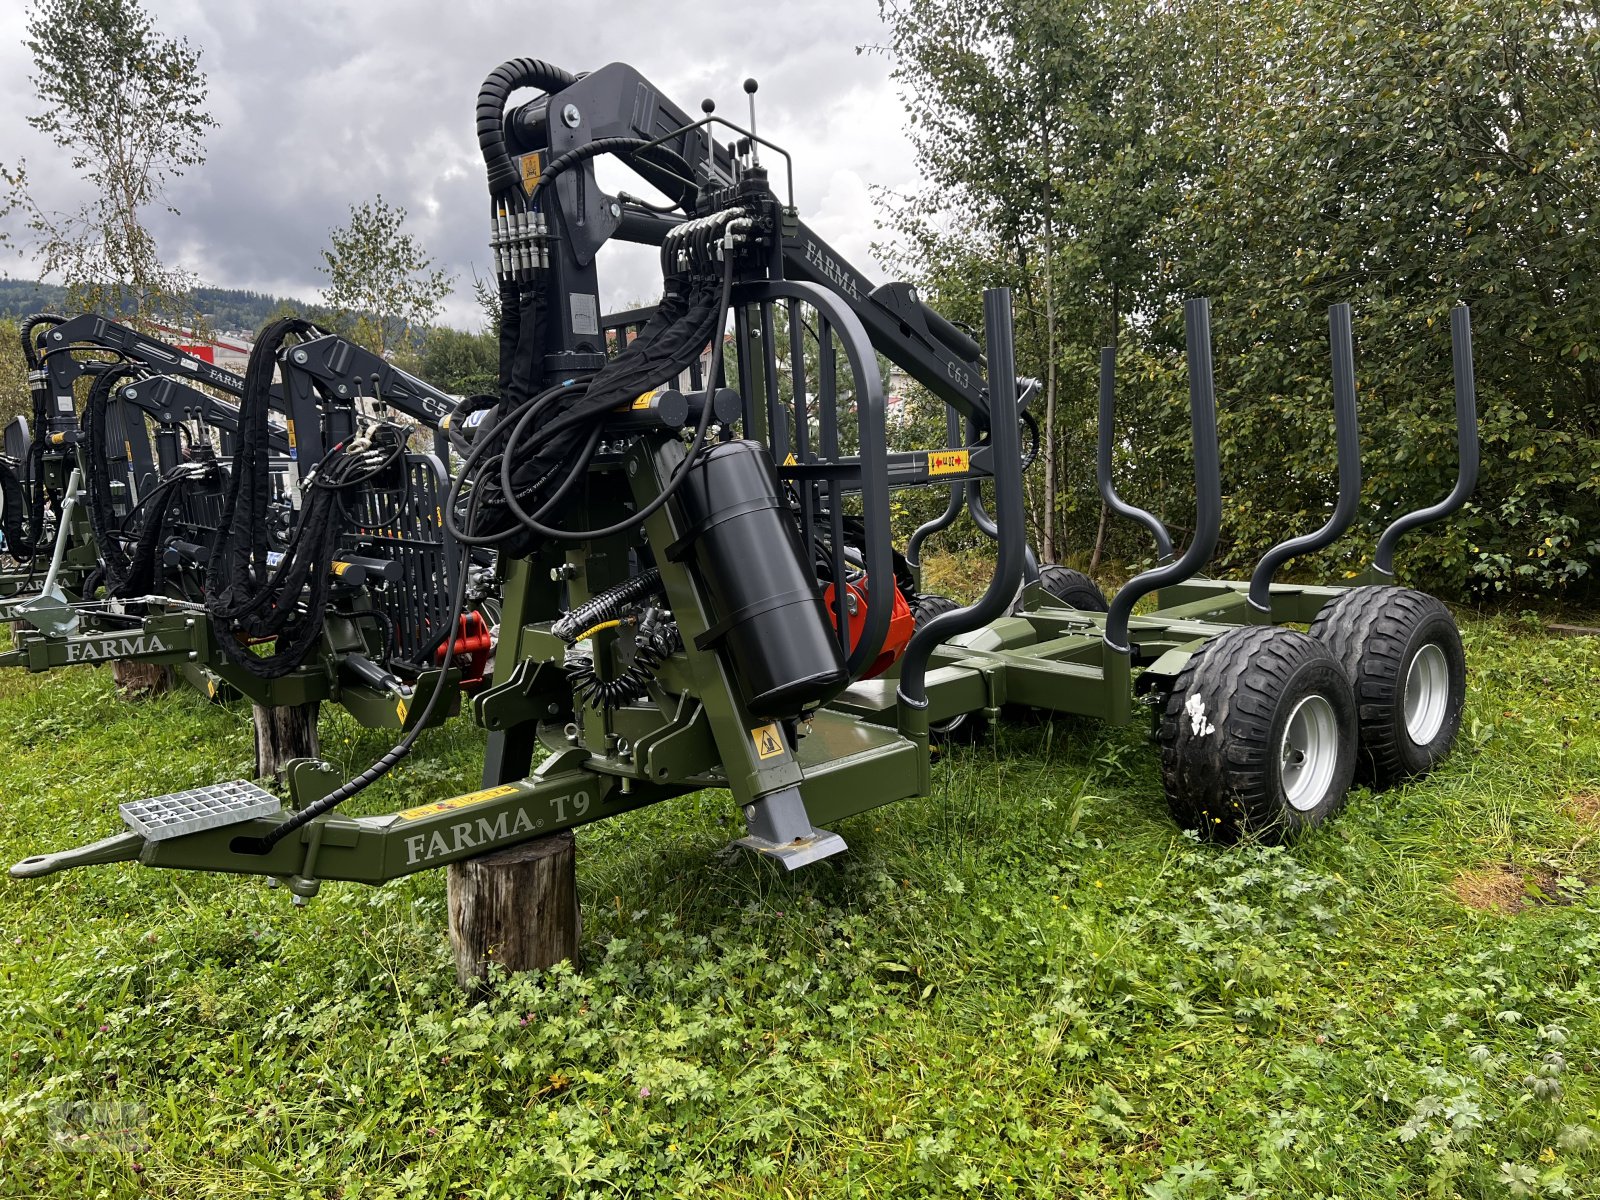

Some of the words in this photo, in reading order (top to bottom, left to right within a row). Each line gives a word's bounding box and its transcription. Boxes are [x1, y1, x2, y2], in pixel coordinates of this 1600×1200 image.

[804, 239, 859, 300] FARMA
[209, 368, 244, 390] FARM
[947, 361, 969, 389] C6.3
[422, 396, 448, 417] C5
[15, 577, 71, 592] FARA
[550, 791, 590, 823] T9
